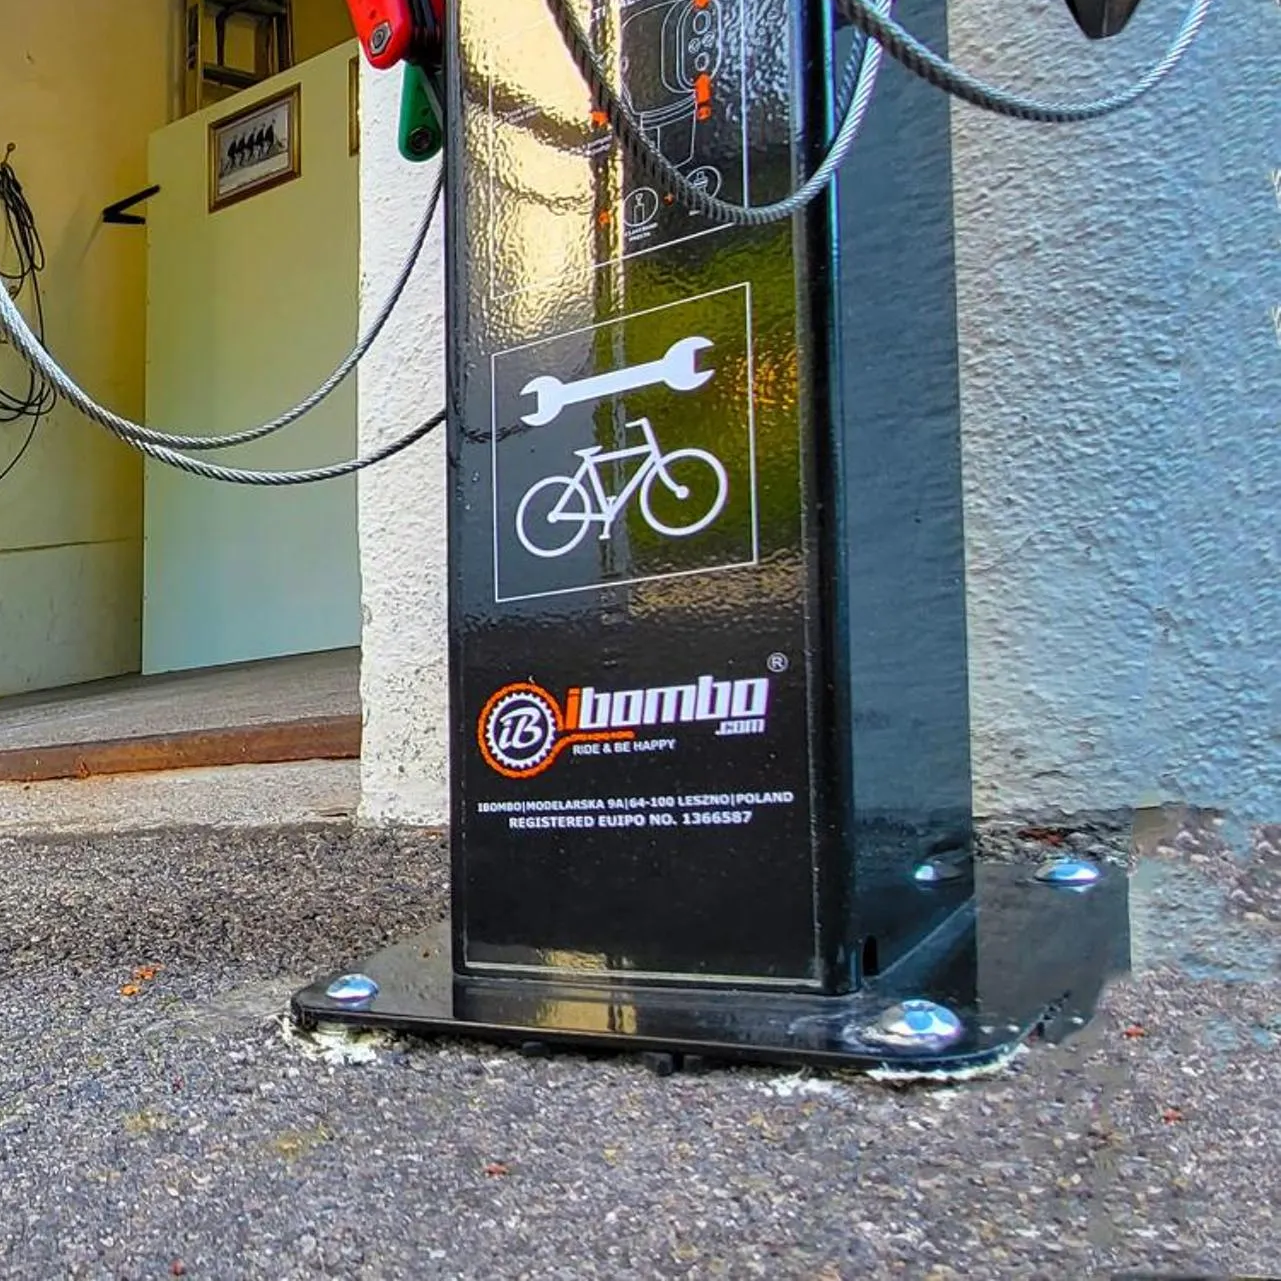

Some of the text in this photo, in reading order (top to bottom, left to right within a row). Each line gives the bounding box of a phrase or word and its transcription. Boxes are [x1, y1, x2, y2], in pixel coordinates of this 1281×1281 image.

[565, 674, 770, 730] ibombo
[714, 718, 766, 736] .com
[572, 737, 677, 756] RIDE & BE HAPPY
[508, 810, 753, 829] REGISTERED EUIPO NO. 1366587
